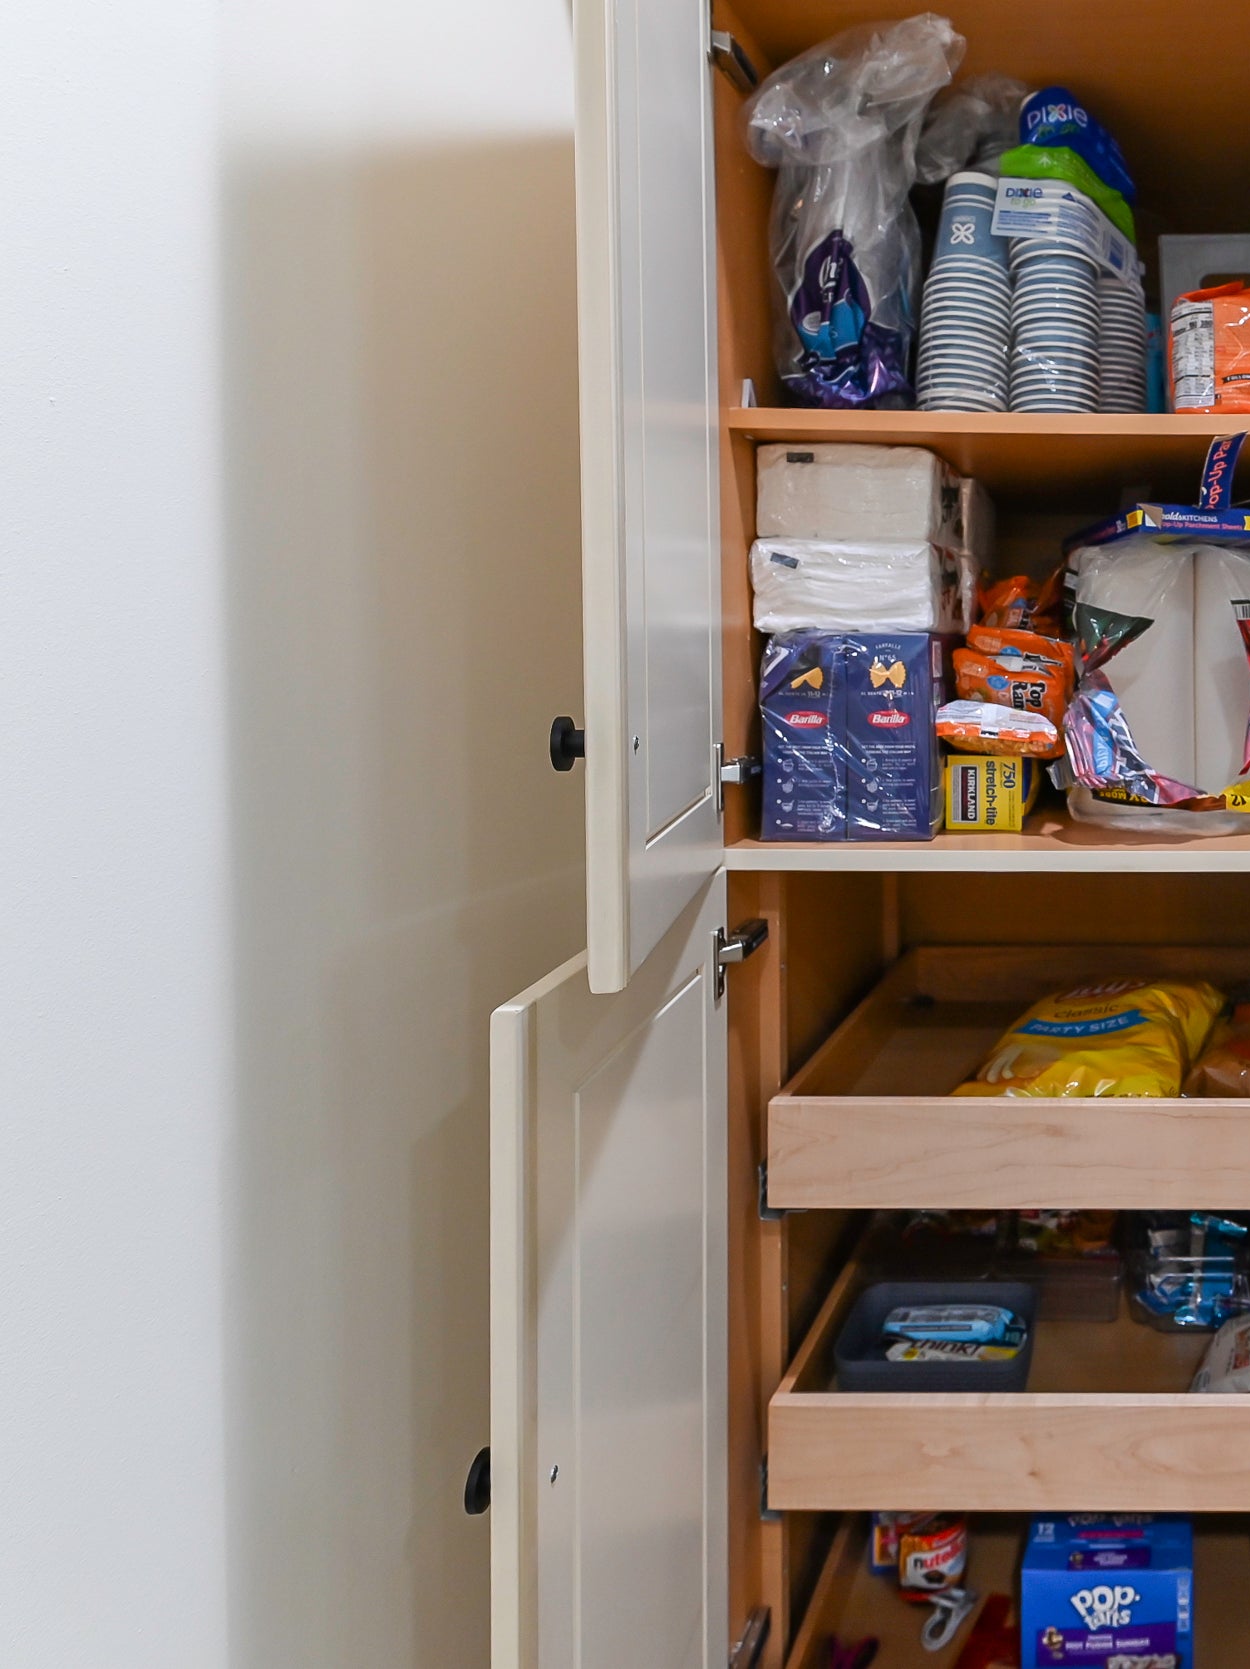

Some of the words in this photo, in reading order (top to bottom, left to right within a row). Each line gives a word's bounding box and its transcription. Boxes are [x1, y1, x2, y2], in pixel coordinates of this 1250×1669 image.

[1161, 521, 1183, 530] op-Up
[1030, 680, 1047, 708] Top
[789, 713, 824, 725] Barilla
[872, 713, 907, 725] Barilla
[1003, 762, 1016, 789] 750
[967, 769, 976, 819] KIRKLAND
[1053, 1003, 1120, 1019] Classic
[1029, 1022, 1085, 1034] PARTY
[1089, 1016, 1130, 1032] SIZE
